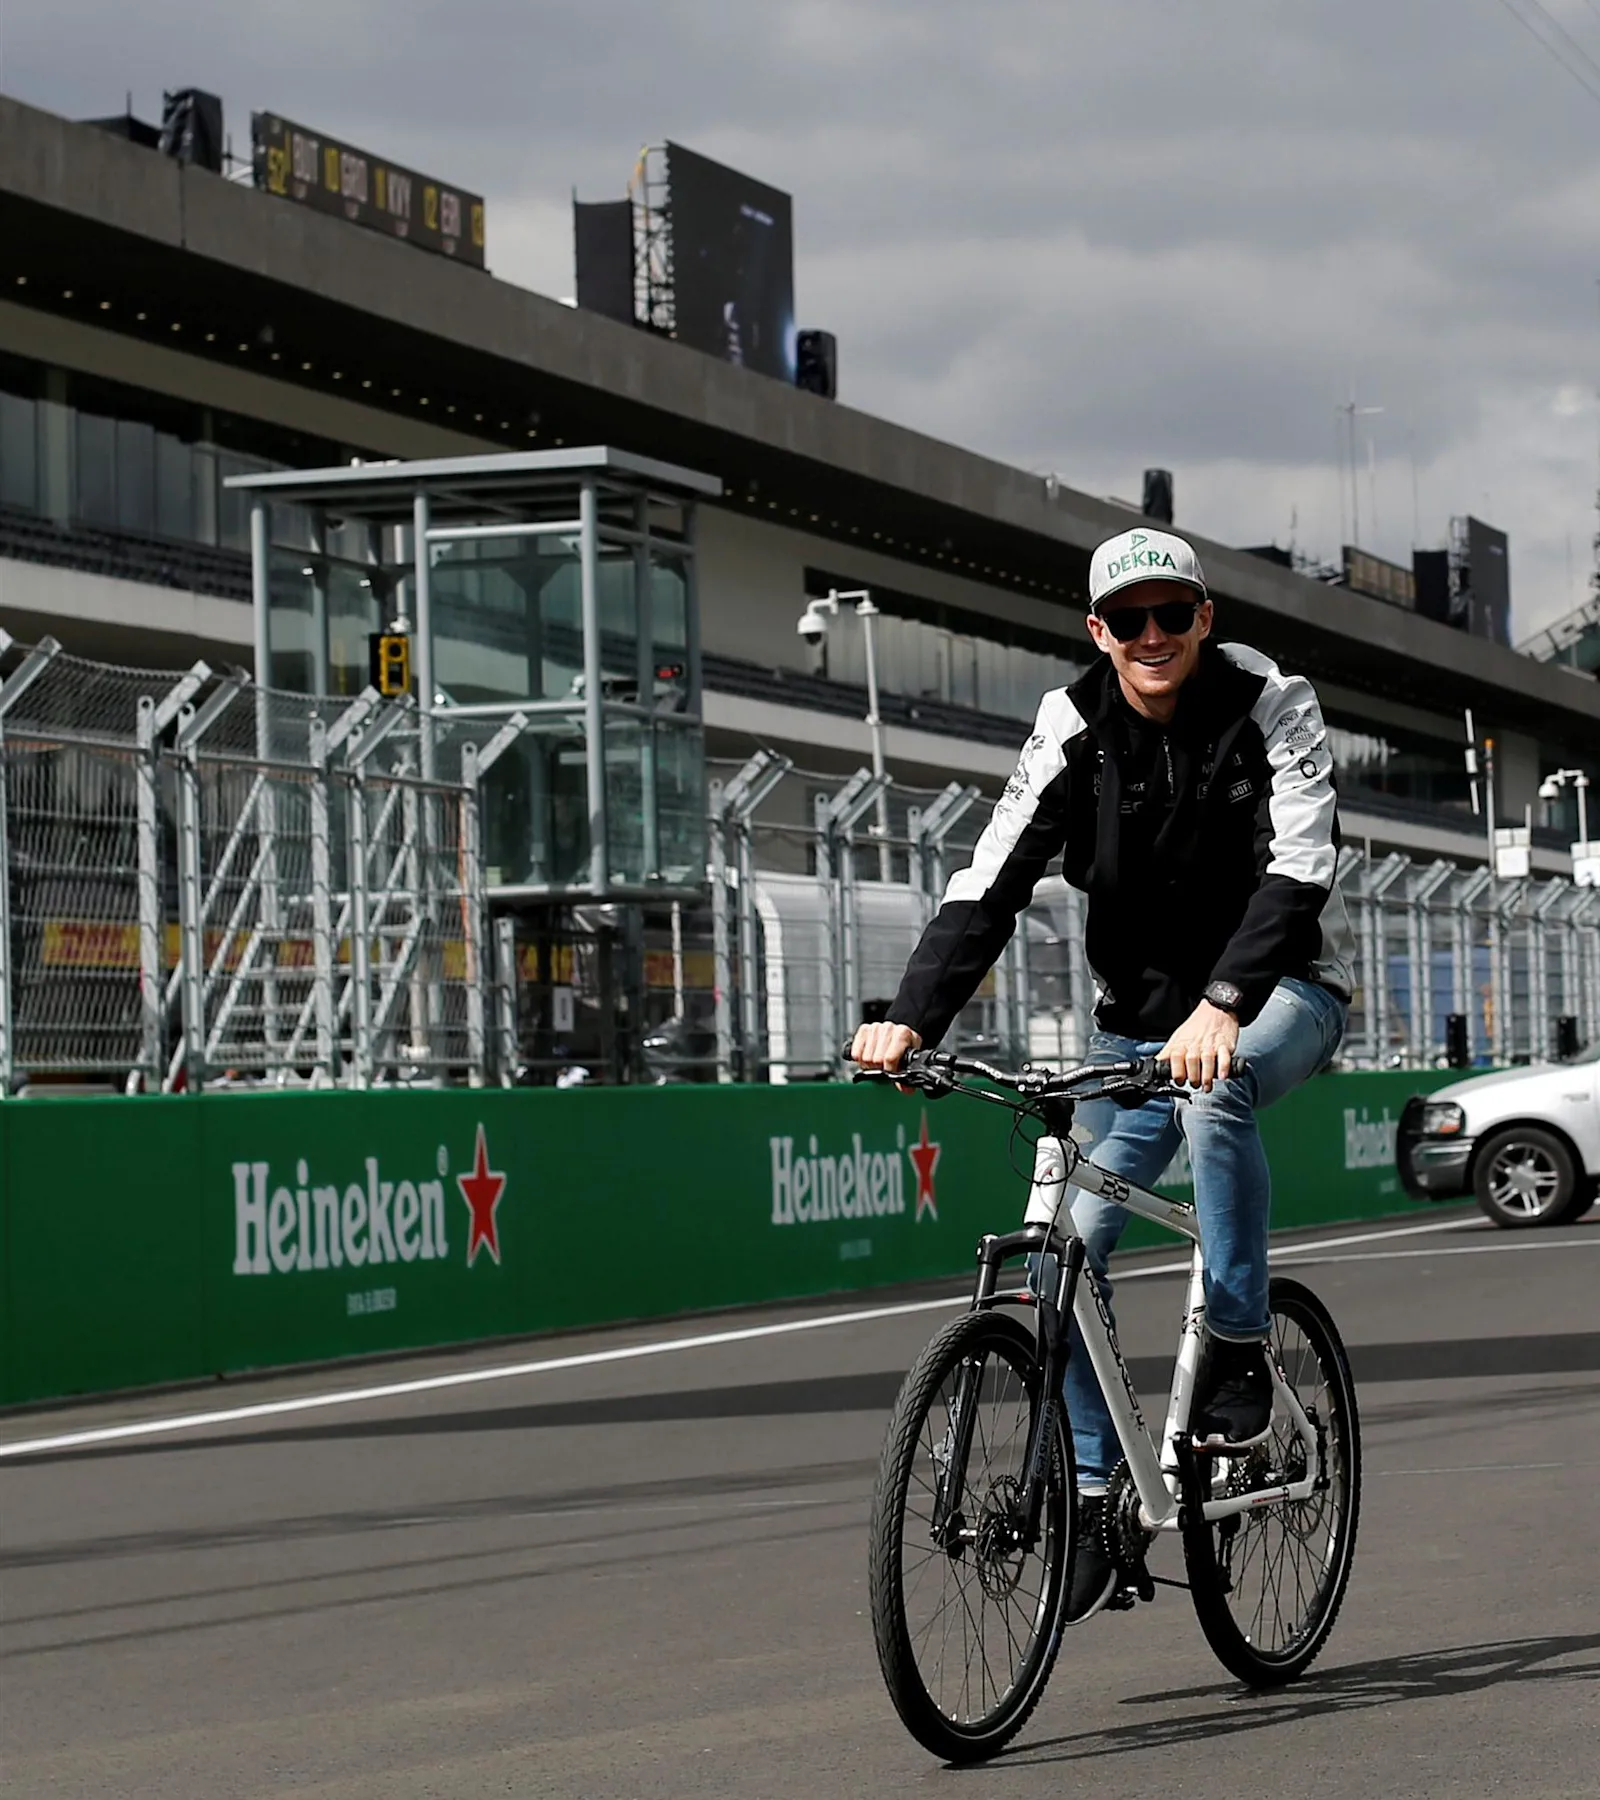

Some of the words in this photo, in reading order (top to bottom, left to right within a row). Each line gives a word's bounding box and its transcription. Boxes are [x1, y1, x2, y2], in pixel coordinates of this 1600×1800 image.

[1107, 550, 1177, 579] DEKRA
[231, 1156, 448, 1275] Heineken
[769, 1132, 906, 1226] Heineken
